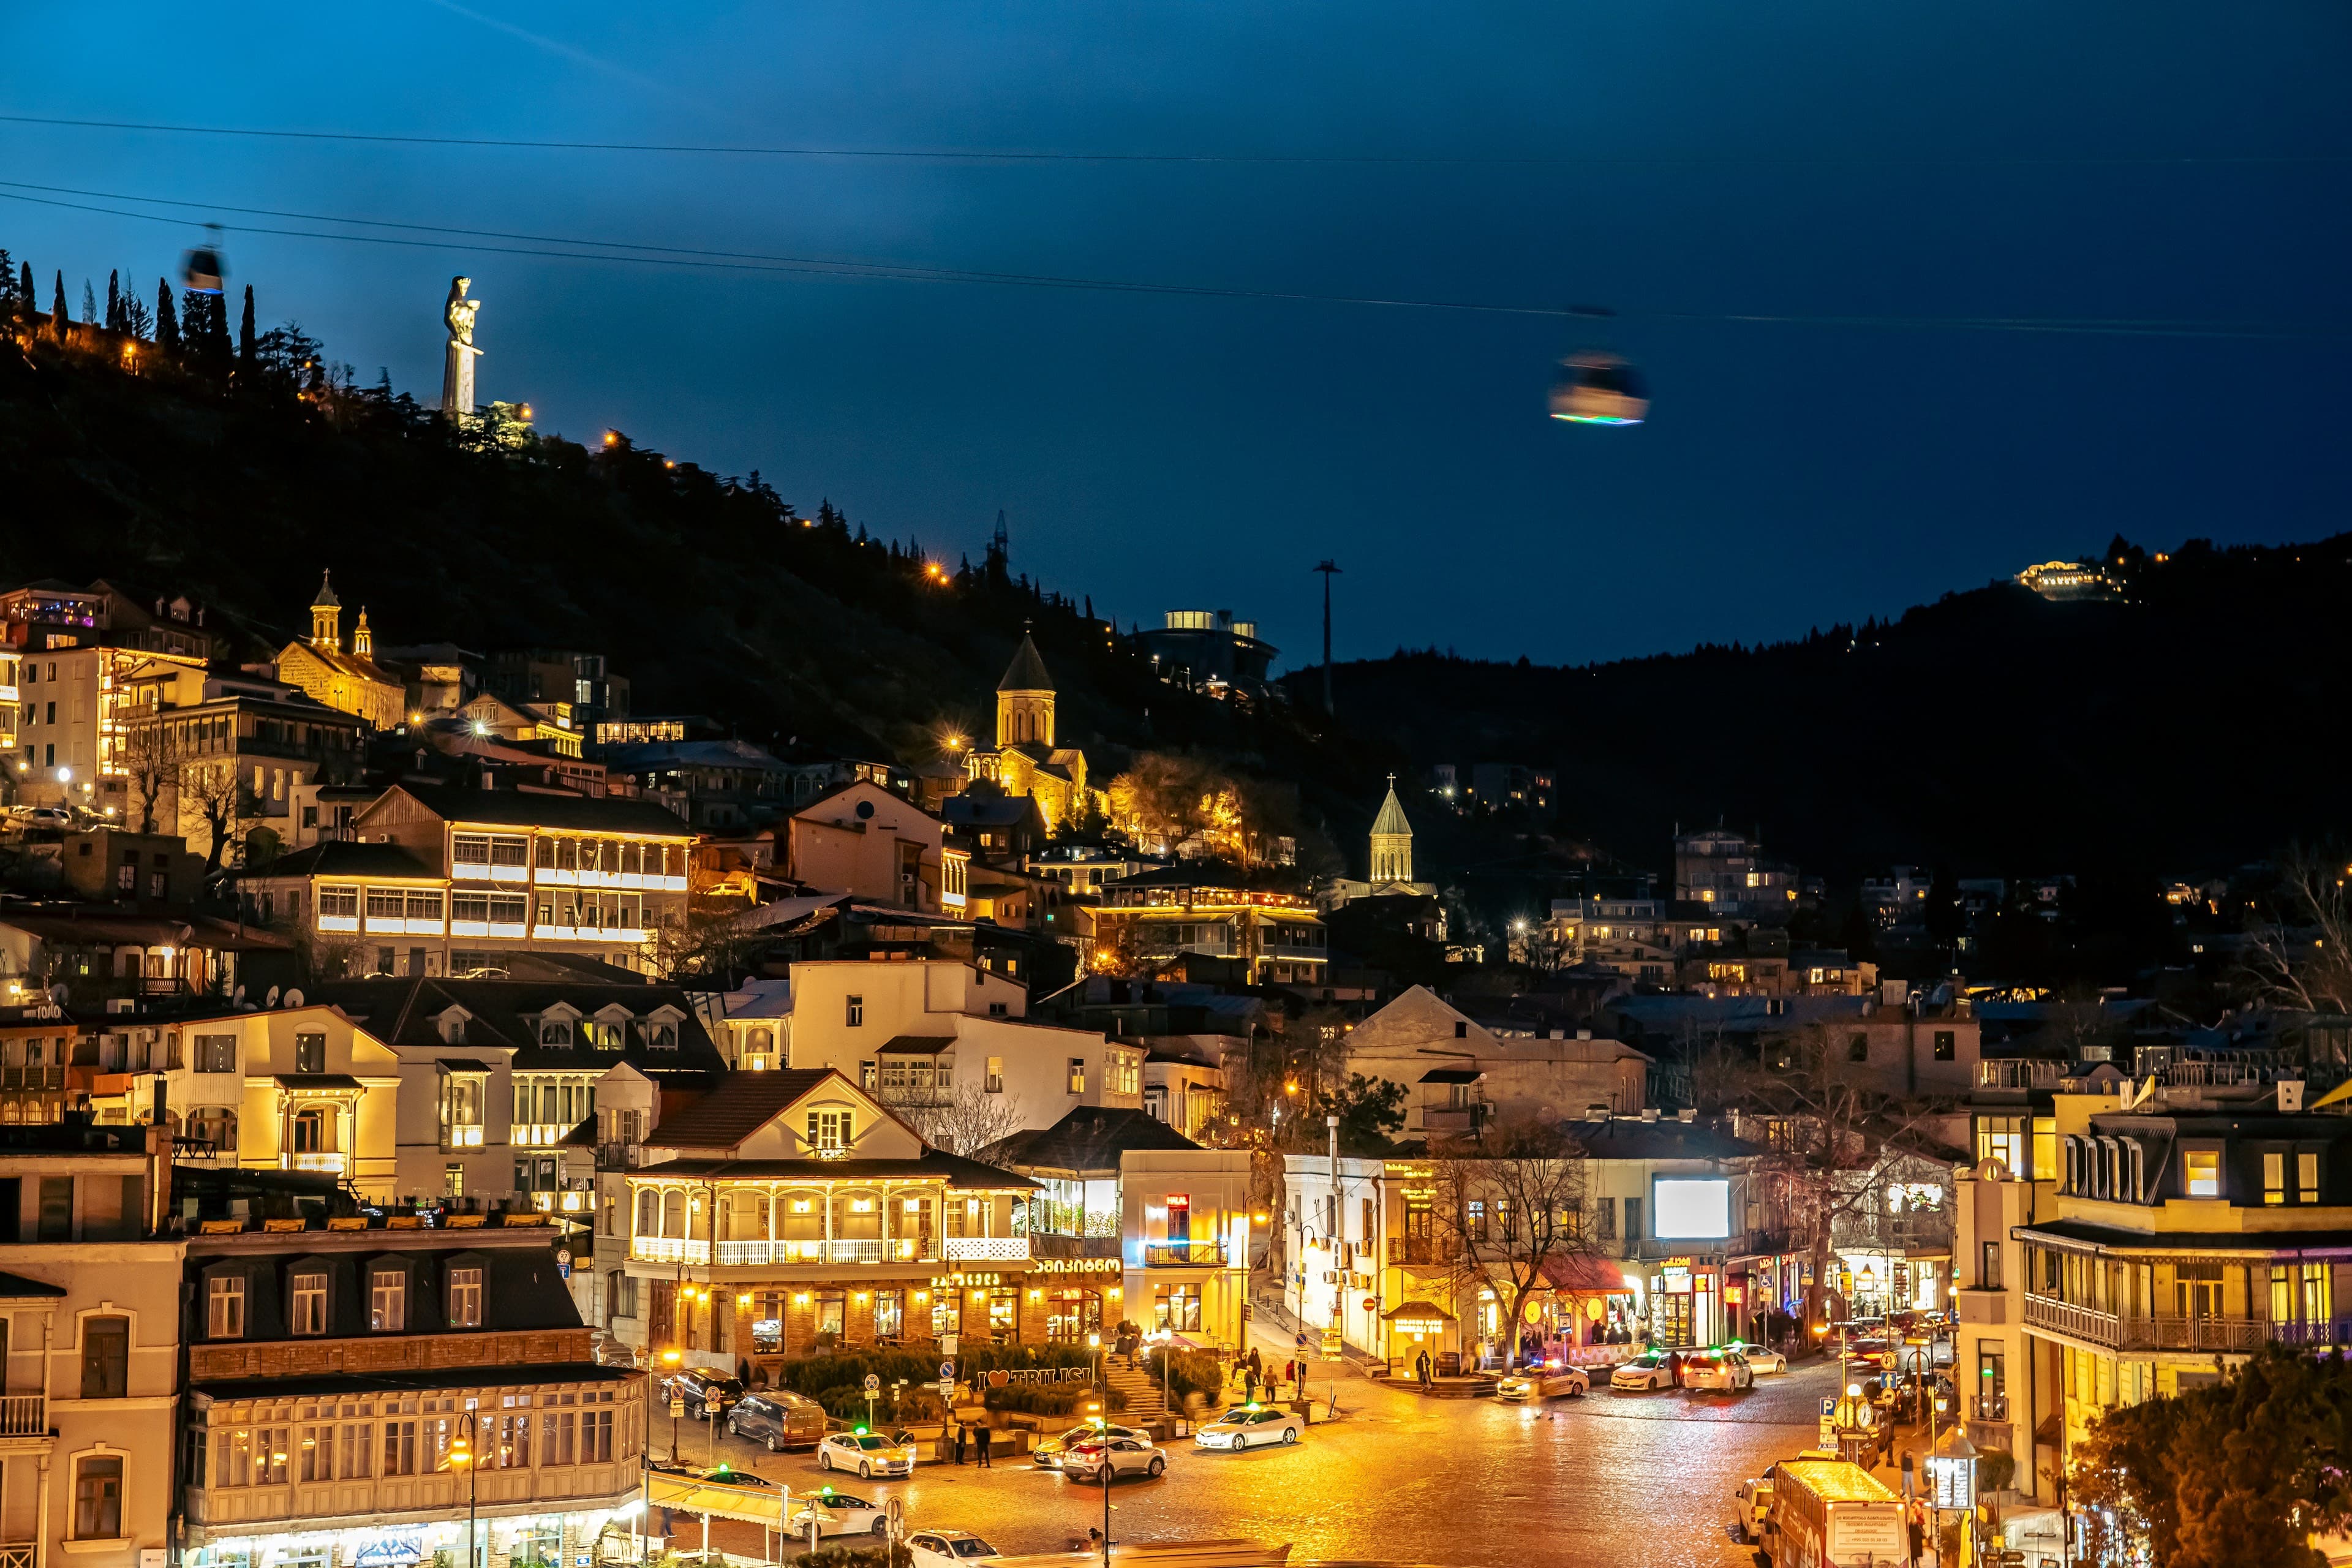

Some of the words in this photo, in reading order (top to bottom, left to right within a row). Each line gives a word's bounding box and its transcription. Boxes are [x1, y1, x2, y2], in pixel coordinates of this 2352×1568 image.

[1166, 1196, 1188, 1205] HALAL
[1024, 1258, 1121, 1273] ამიკიტნო
[1782, 1254, 1796, 1265] SPAR
[978, 1371, 987, 1392] I
[1011, 1367, 1090, 1387] TBILISI
[1823, 1400, 1833, 1414] P
